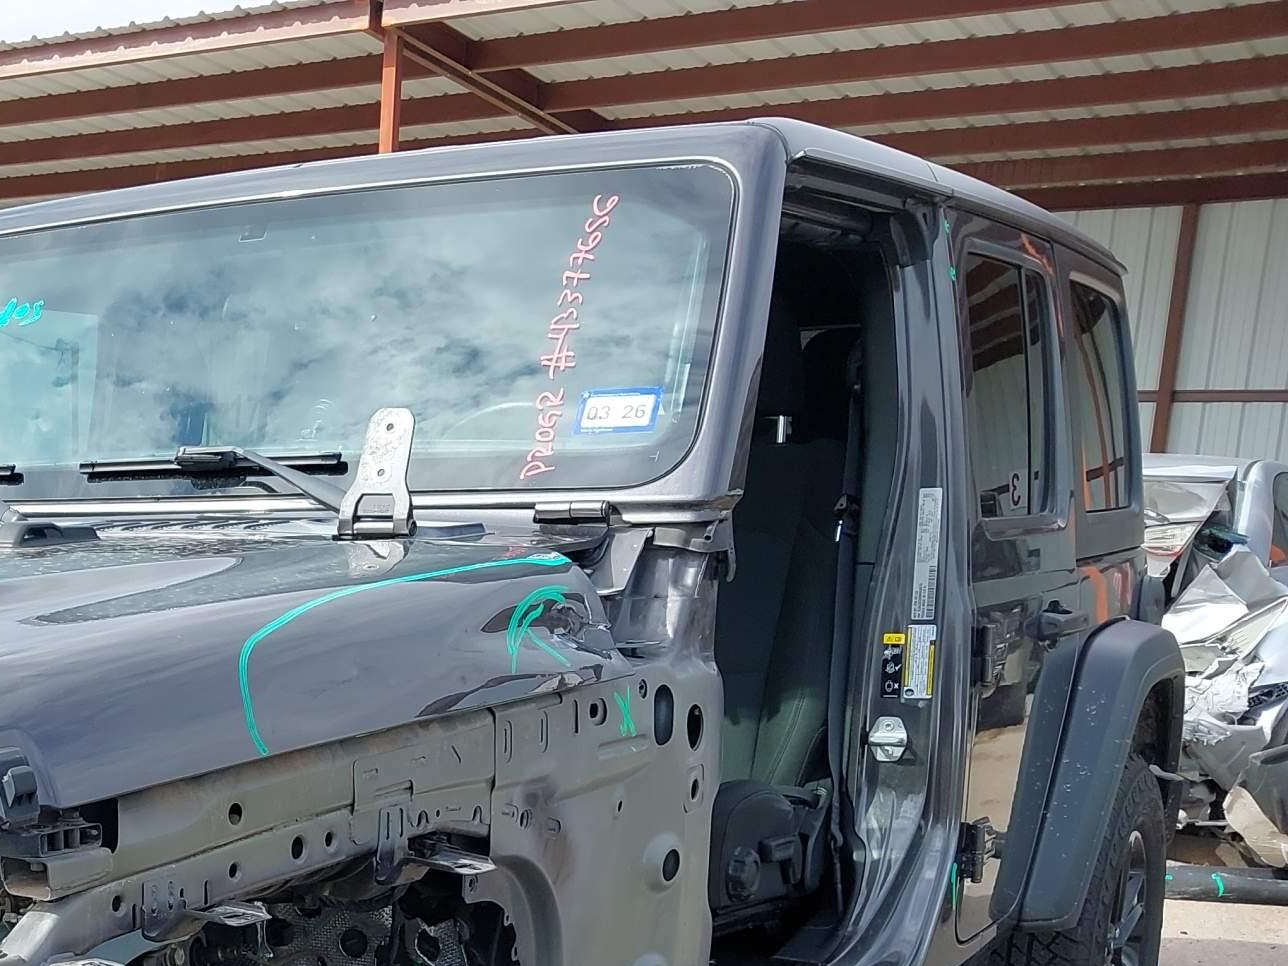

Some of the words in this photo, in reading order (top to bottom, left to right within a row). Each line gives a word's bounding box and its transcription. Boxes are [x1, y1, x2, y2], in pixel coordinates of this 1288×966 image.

[539, 193, 620, 380] #43377656
[586, 405, 611, 421] 03
[621, 403, 648, 420] 26
